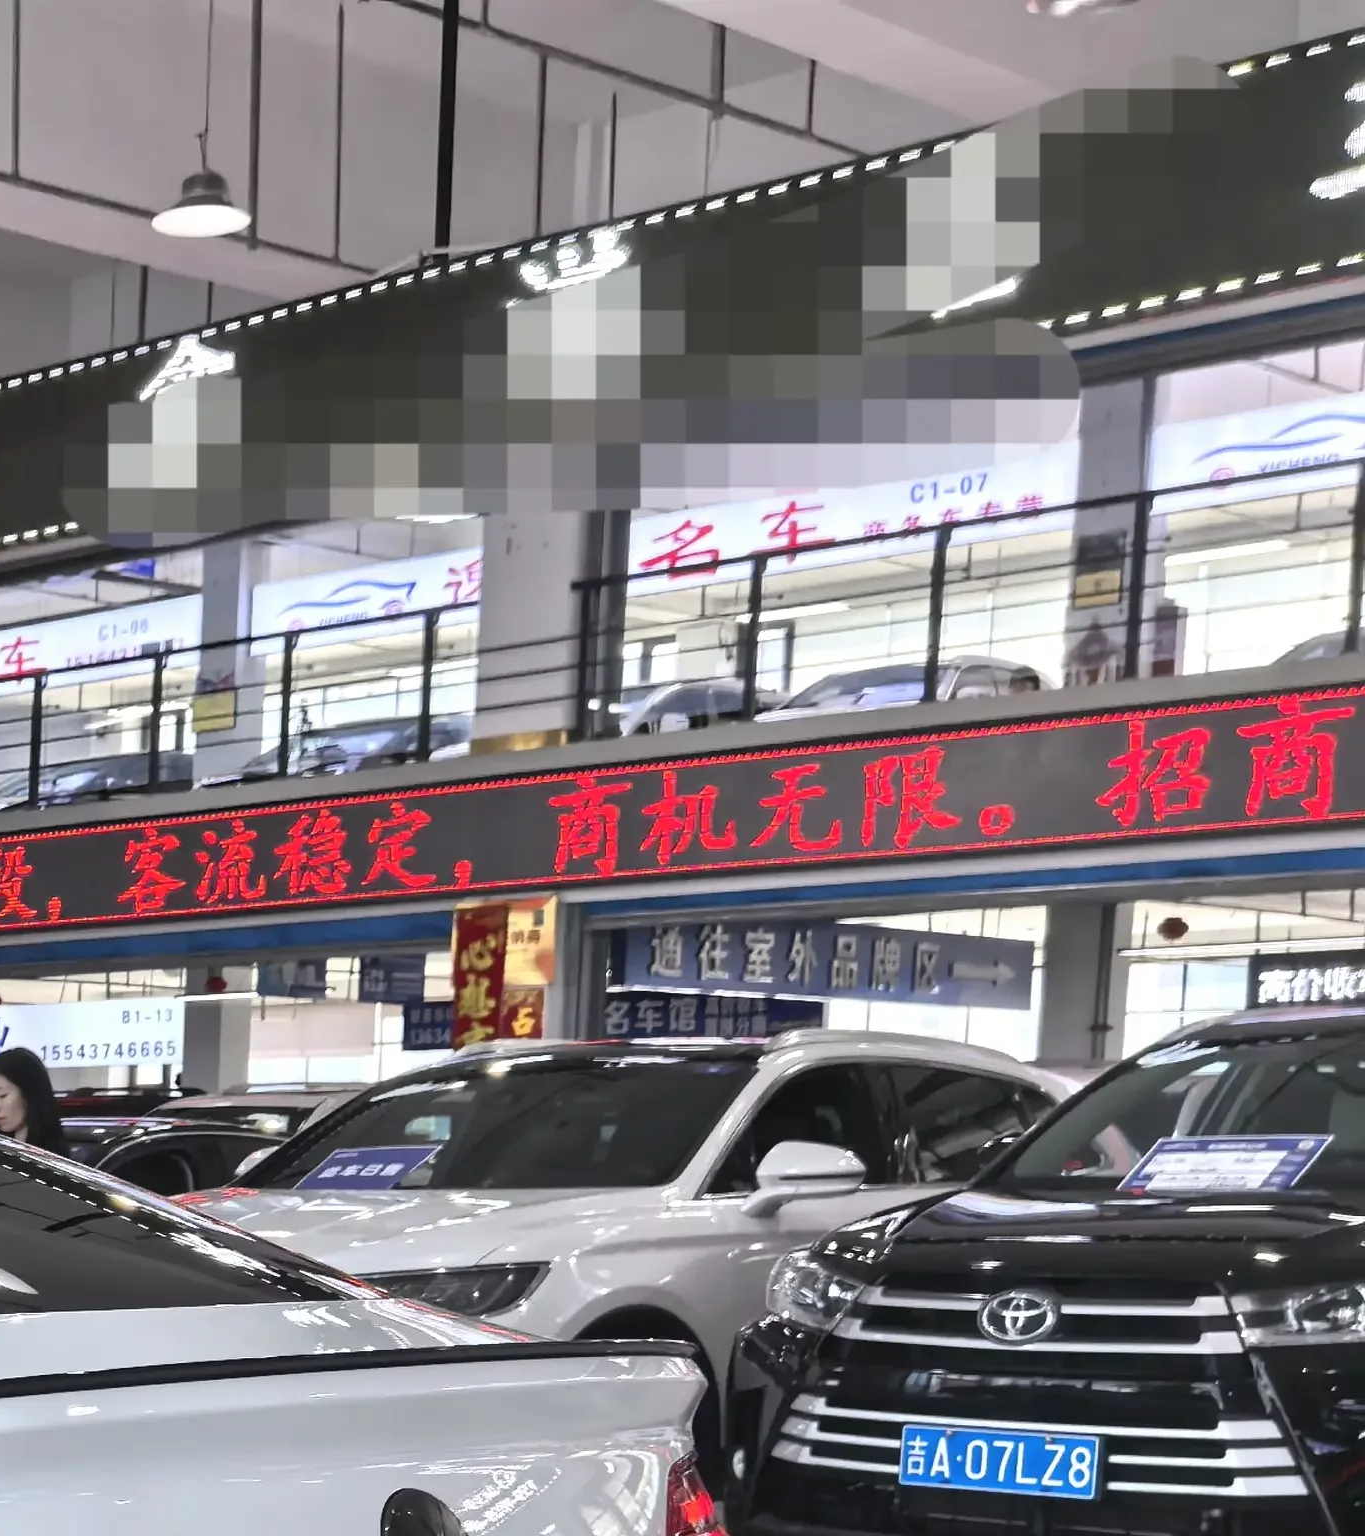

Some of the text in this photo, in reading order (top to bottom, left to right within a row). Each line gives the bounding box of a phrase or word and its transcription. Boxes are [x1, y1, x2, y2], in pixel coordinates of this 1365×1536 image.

[911, 472, 989, 503] C1-07
[638, 500, 837, 580] 名车
[1096, 697, 1357, 828] 招商
[548, 744, 1016, 878] 商机无限。
[648, 923, 942, 995] 通往室外品牌区
[1257, 965, 1365, 1004] 高价收
[121, 1008, 174, 1025] B1-13
